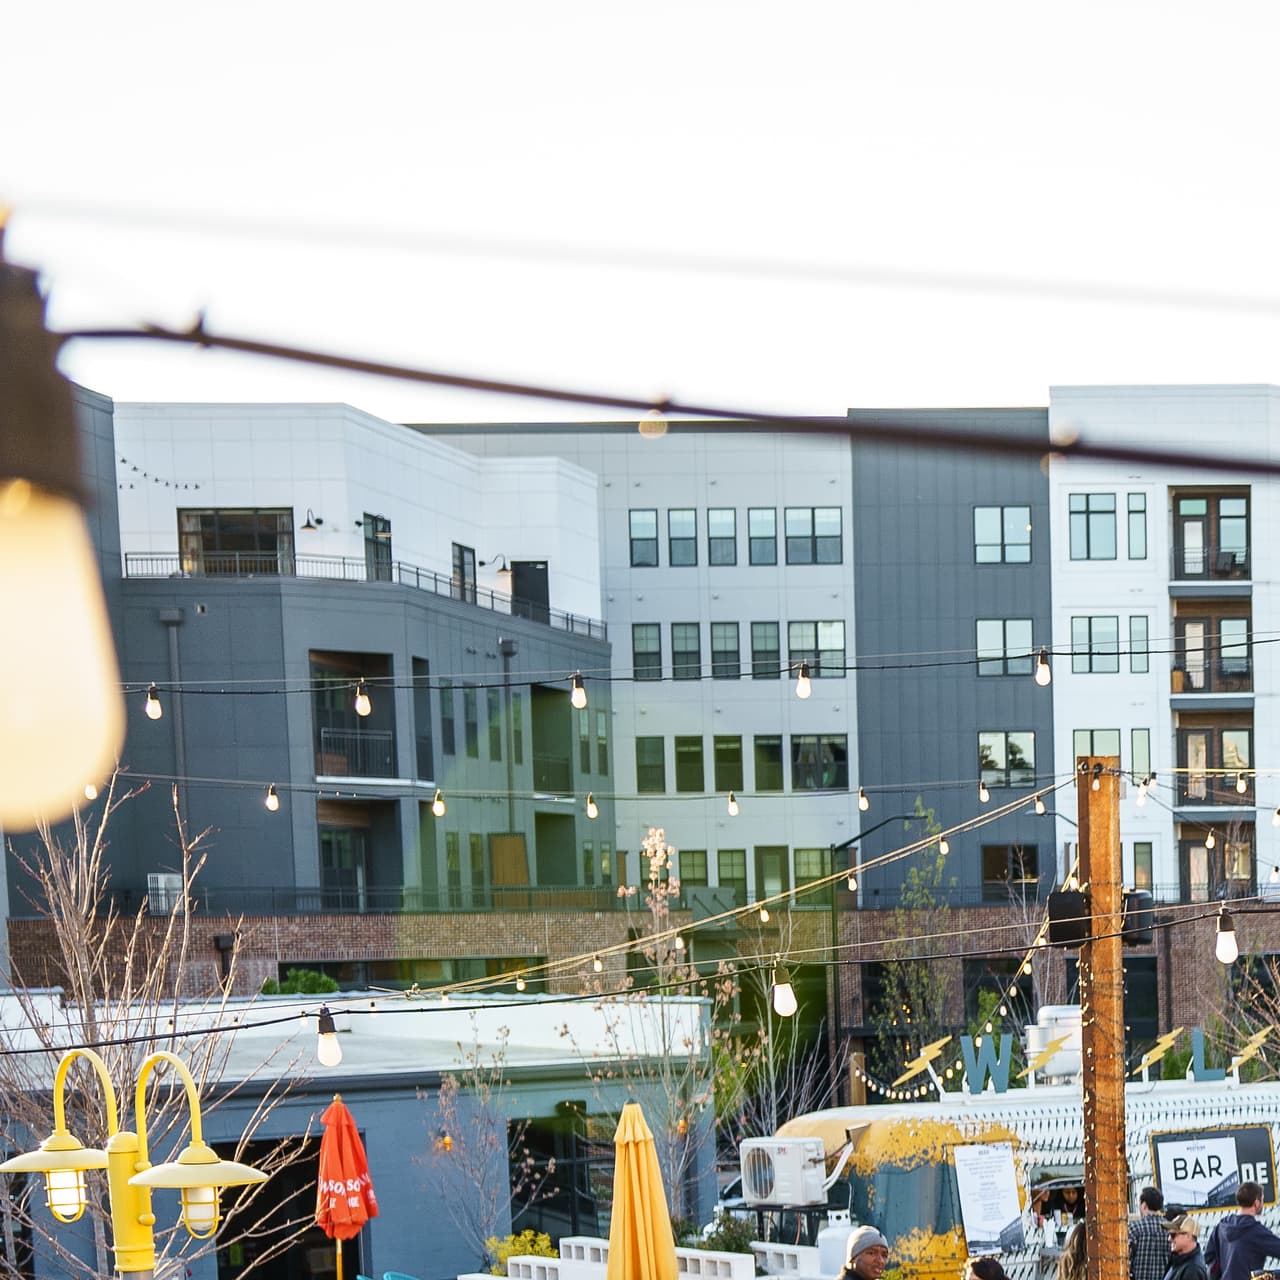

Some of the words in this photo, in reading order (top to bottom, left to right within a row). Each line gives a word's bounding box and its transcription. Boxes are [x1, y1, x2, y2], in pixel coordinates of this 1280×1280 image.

[960, 1034, 1013, 1095] W
[1191, 1027, 1226, 1082] L
[1172, 1154, 1223, 1181] BAR
